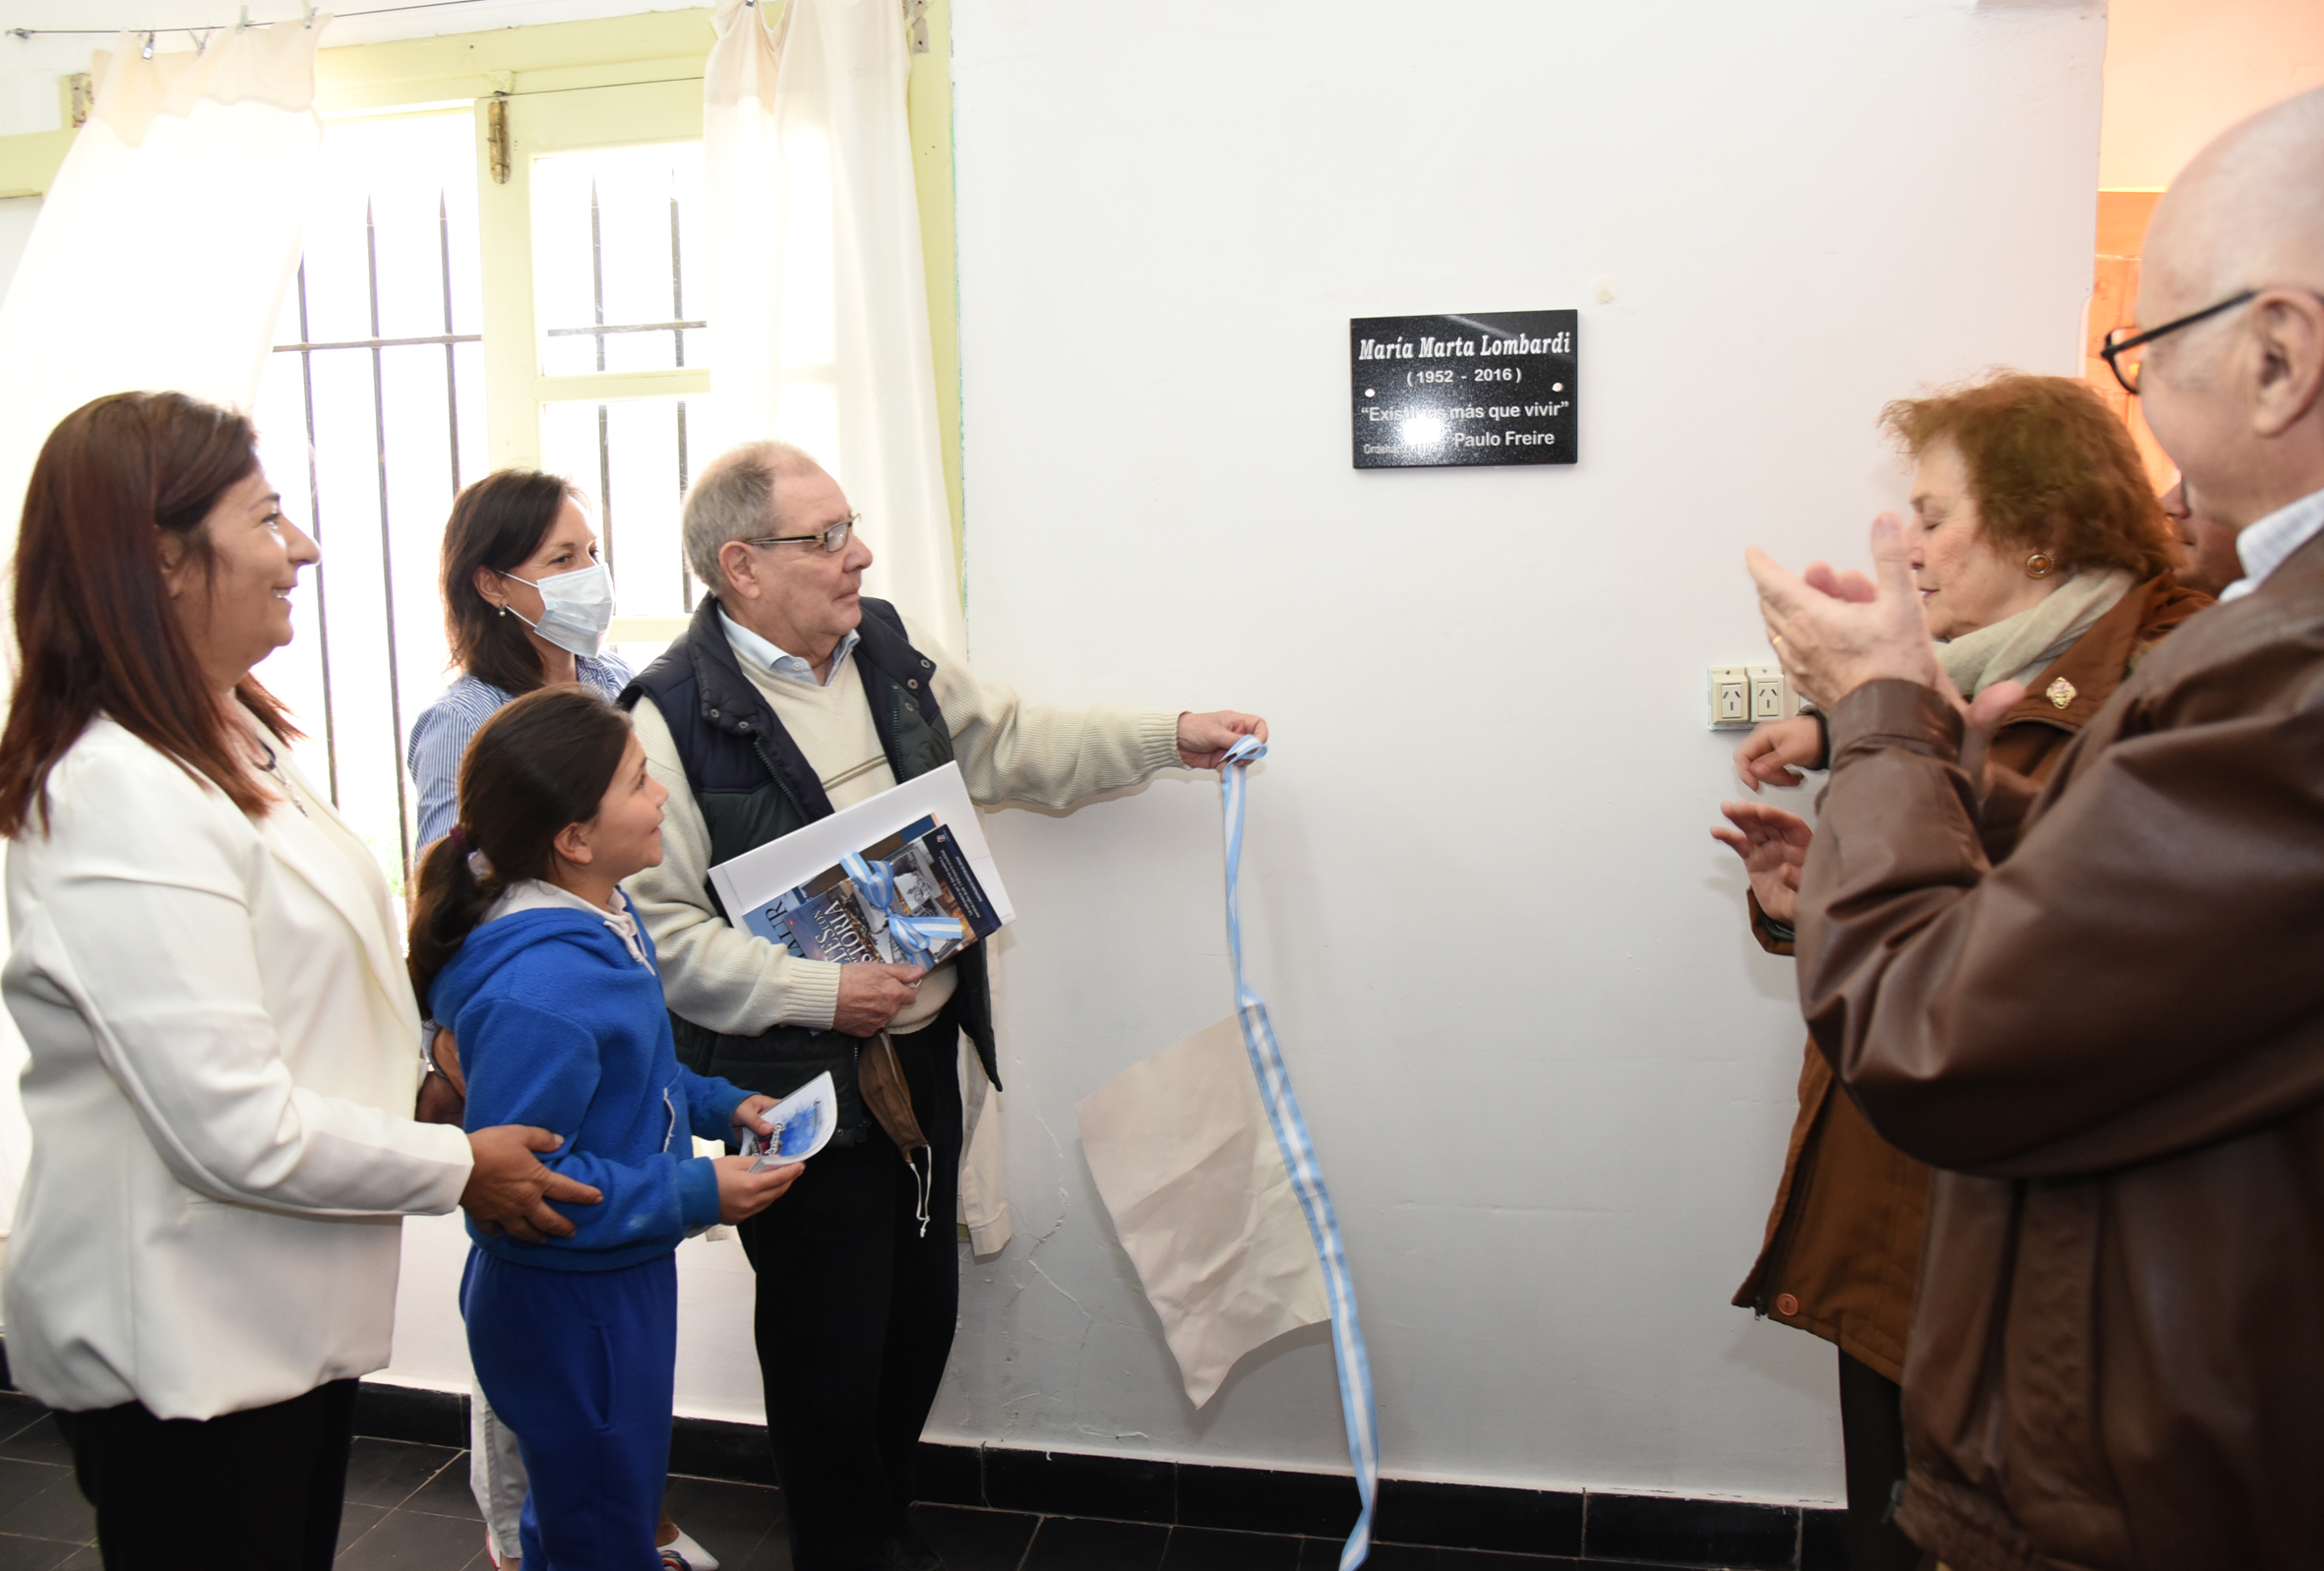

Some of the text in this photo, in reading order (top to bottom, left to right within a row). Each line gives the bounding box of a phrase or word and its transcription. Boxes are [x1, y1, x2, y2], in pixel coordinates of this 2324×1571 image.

[1359, 332, 1571, 360] María Marta Lombardi
[1416, 370, 1453, 384] 1952
[1475, 369, 1512, 382] 2016
[1450, 404, 1484, 418] más
[1489, 404, 1520, 421] que
[1454, 431, 1555, 448] Paulo Freire
[812, 909, 831, 930] CON
